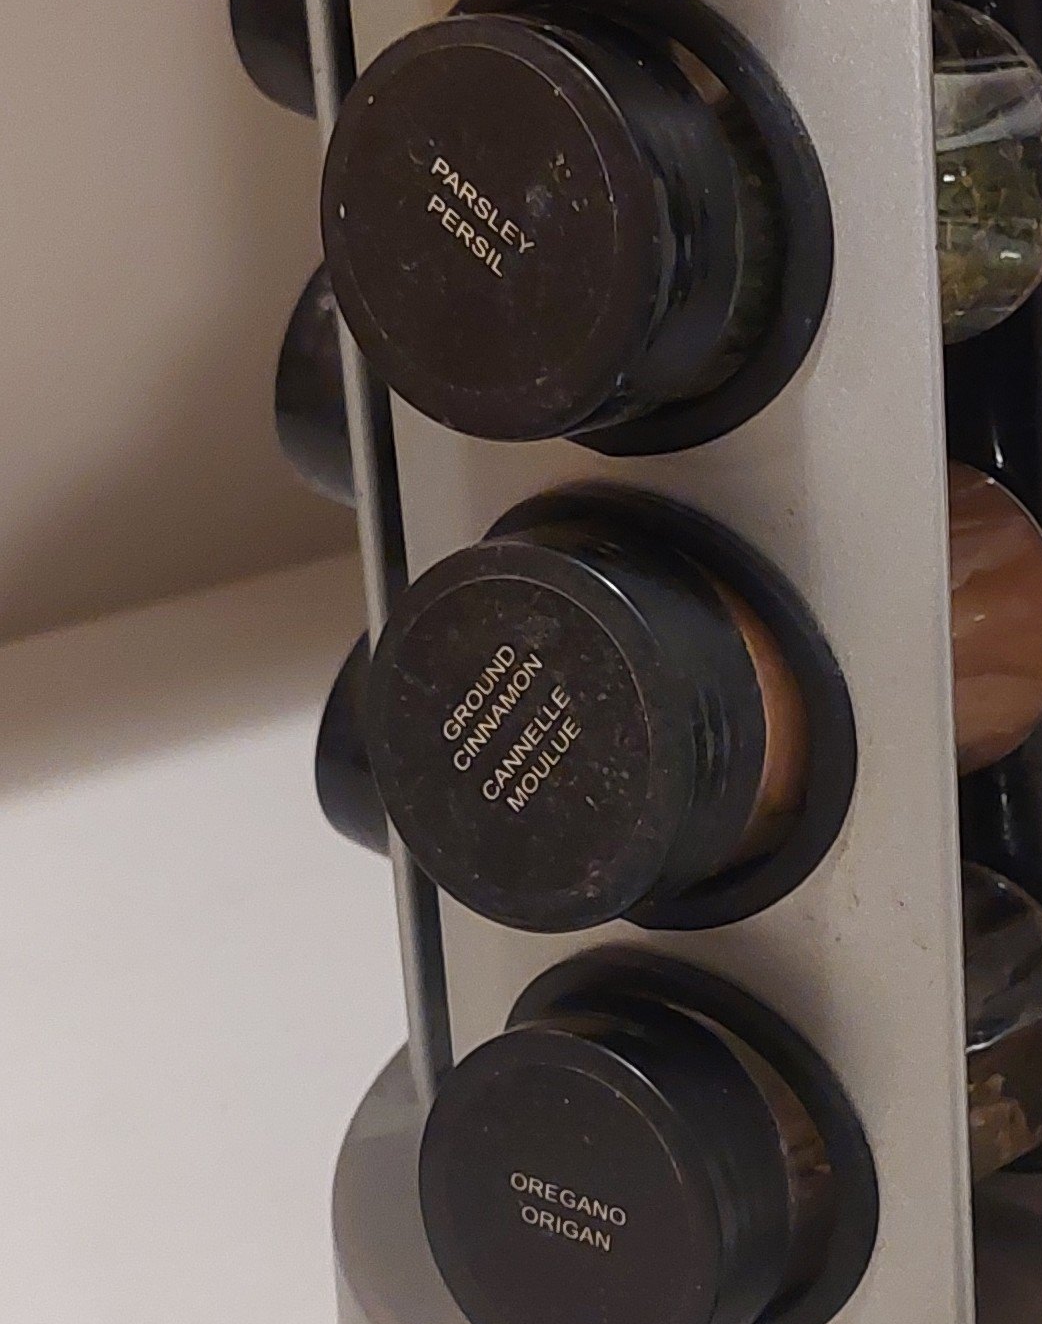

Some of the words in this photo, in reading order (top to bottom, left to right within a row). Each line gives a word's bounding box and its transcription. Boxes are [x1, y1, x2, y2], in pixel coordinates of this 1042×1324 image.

[427, 193, 503, 278] PERSIL
[430, 156, 536, 255] PARSLEY
[442, 644, 516, 741] GROUND
[453, 652, 543, 771] CINNAMON
[482, 684, 571, 800] CANNELLE
[506, 715, 582, 813] MOULUE
[510, 1171, 627, 1226] OREGANO
[521, 1205, 611, 1252] ORIGAN
